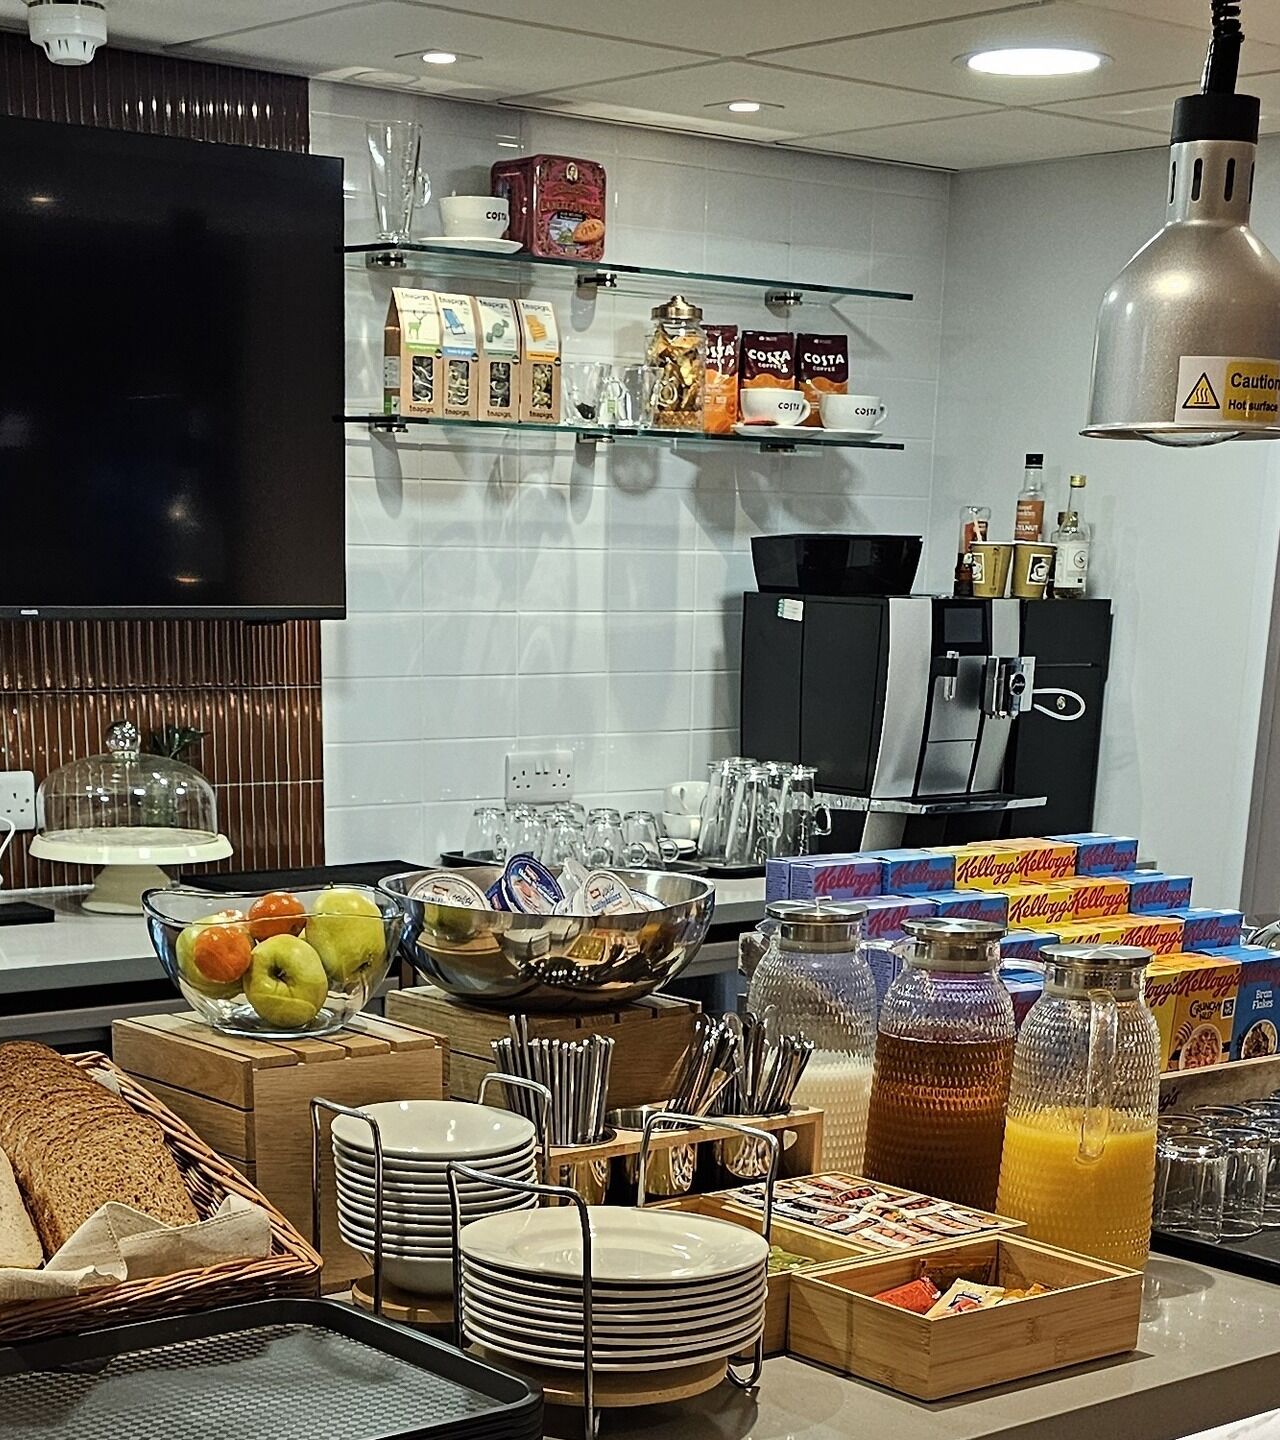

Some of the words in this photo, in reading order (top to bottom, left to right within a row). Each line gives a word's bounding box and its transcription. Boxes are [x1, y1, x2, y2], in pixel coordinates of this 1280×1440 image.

[748, 349, 791, 363] COSTA
[804, 353, 845, 366] COSTA
[1231, 373, 1280, 390] Caution
[1228, 399, 1246, 410] Hot
[1248, 400, 1278, 412] surface
[957, 854, 1020, 885] Kellogg's
[1019, 848, 1077, 878] Kellogg's
[1009, 895, 1073, 923] Kellogg's
[1072, 886, 1130, 916] Kellogg's
[1123, 924, 1184, 955] Kellogg's
[1178, 964, 1242, 997] Kellogg's
[1255, 989, 1273, 1000] Bran
[1190, 1000, 1222, 1018] CRUNCHY
[1252, 998, 1274, 1010] Flakes
